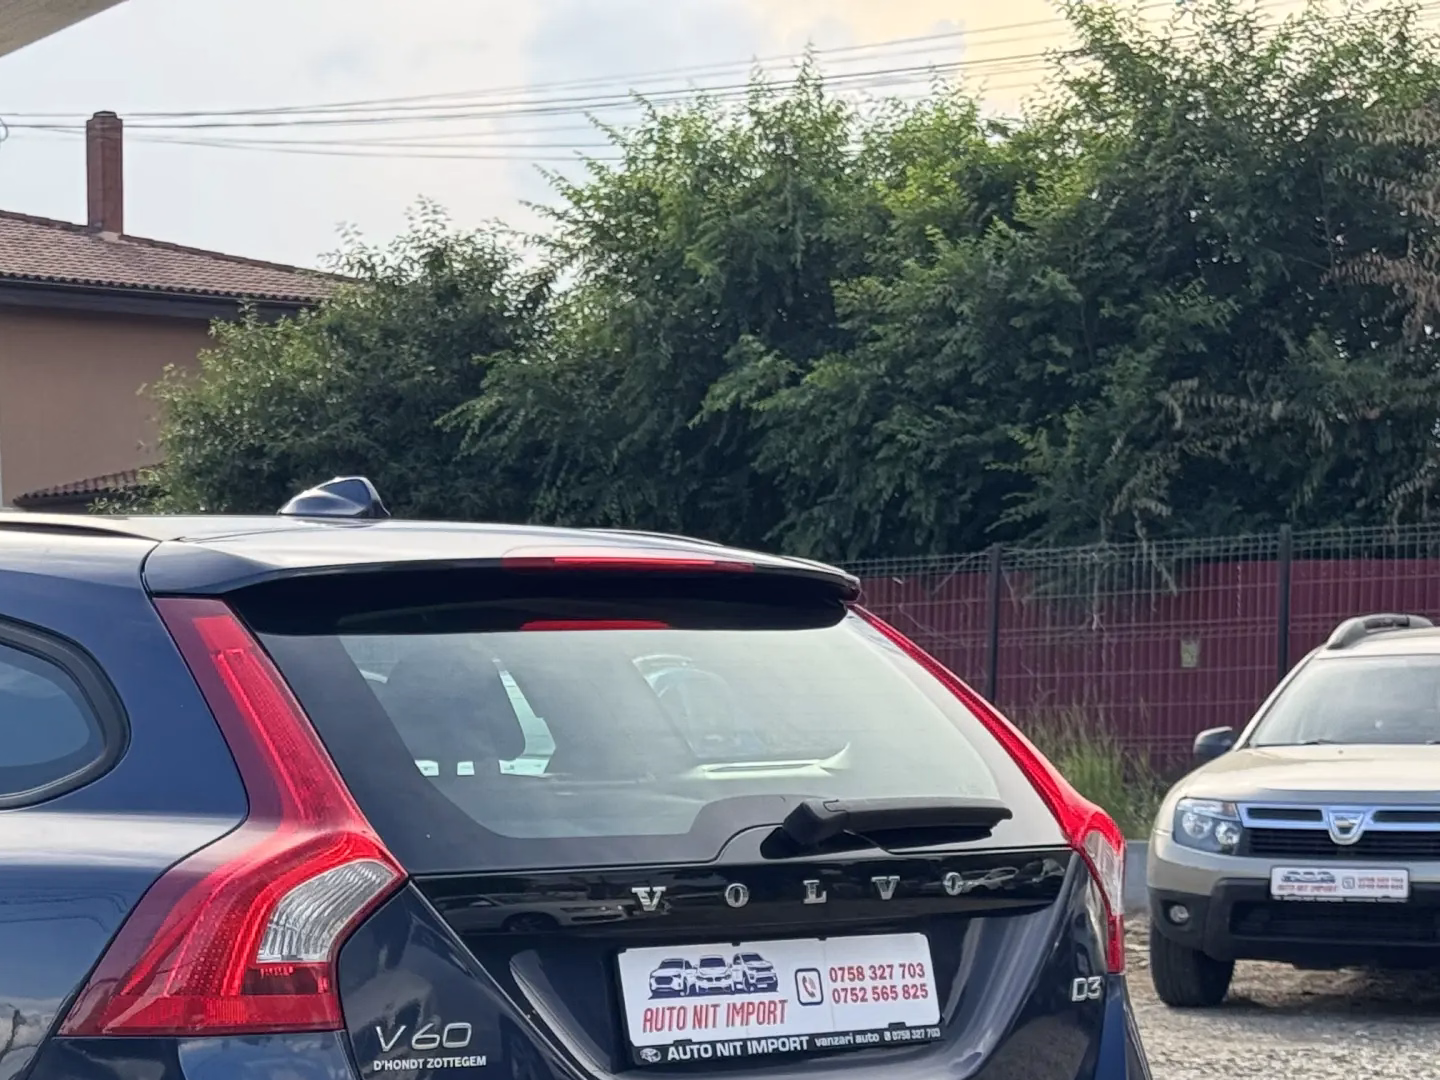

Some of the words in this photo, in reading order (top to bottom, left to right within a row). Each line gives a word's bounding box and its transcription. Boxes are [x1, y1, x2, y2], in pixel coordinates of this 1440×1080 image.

[631, 872, 962, 912] VOLVO
[829, 965, 866, 983] 0758
[868, 964, 894, 981] 327
[898, 962, 925, 980] 703
[832, 987, 868, 1004] 0752
[871, 985, 898, 1002] 565
[901, 983, 928, 1000] 825
[1072, 975, 1103, 1002] D3
[642, 1006, 688, 1033] AUTO
[692, 1003, 721, 1030] NIT
[725, 999, 789, 1028] IMPORT
[375, 1022, 472, 1052] V60
[667, 1044, 713, 1061] AUTO
[716, 1041, 744, 1057] NIT
[747, 1036, 810, 1055] IMPORT
[814, 1033, 854, 1047] vanzari
[855, 1033, 880, 1044] auto
[373, 1058, 425, 1071] D'HONDT
[426, 1055, 487, 1069] ZOTTEGEM
